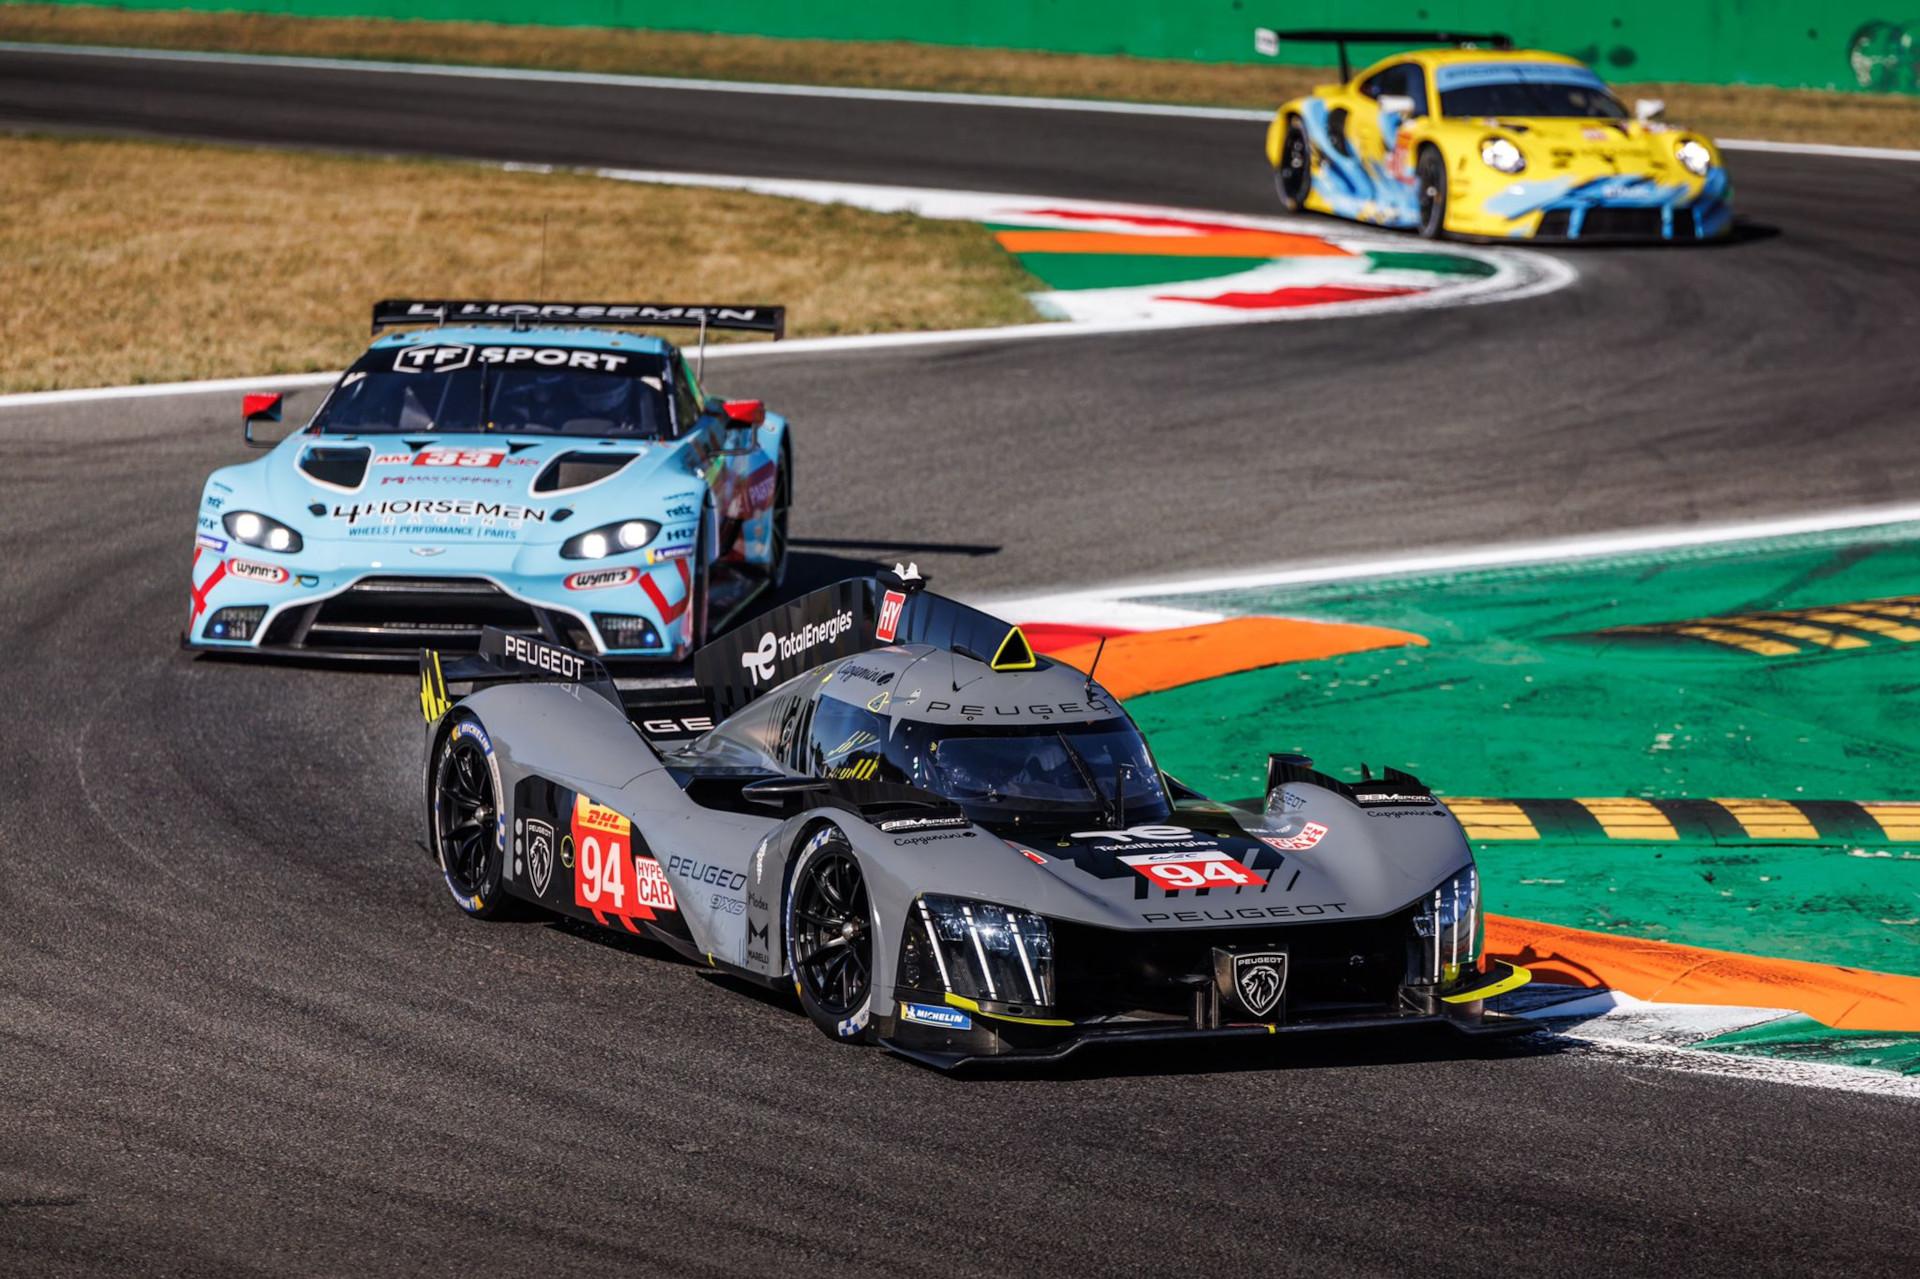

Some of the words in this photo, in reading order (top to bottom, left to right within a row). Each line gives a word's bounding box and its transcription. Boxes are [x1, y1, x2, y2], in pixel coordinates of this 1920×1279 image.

[461, 303, 756, 320] HORSEMEN
[408, 347, 464, 366] TF
[478, 347, 628, 371] SPORT
[349, 525, 389, 537] WHEELS
[399, 526, 472, 537] PERFORMANCE
[484, 529, 517, 539] PARTS
[880, 599, 901, 632] HY
[778, 609, 853, 661] TotalEnergies
[505, 635, 584, 680] PEUGEOT
[587, 809, 620, 830] DHL
[1094, 840, 1219, 852] TotalEnergies
[581, 836, 625, 908] 94
[638, 861, 666, 880] HYPE
[1150, 861, 1248, 886] 94
[639, 878, 672, 905] CAR
[1142, 903, 1347, 923] PEUGEOT
[1238, 957, 1282, 966] PEUGEOT
[917, 1009, 964, 1023] MICHELIN
